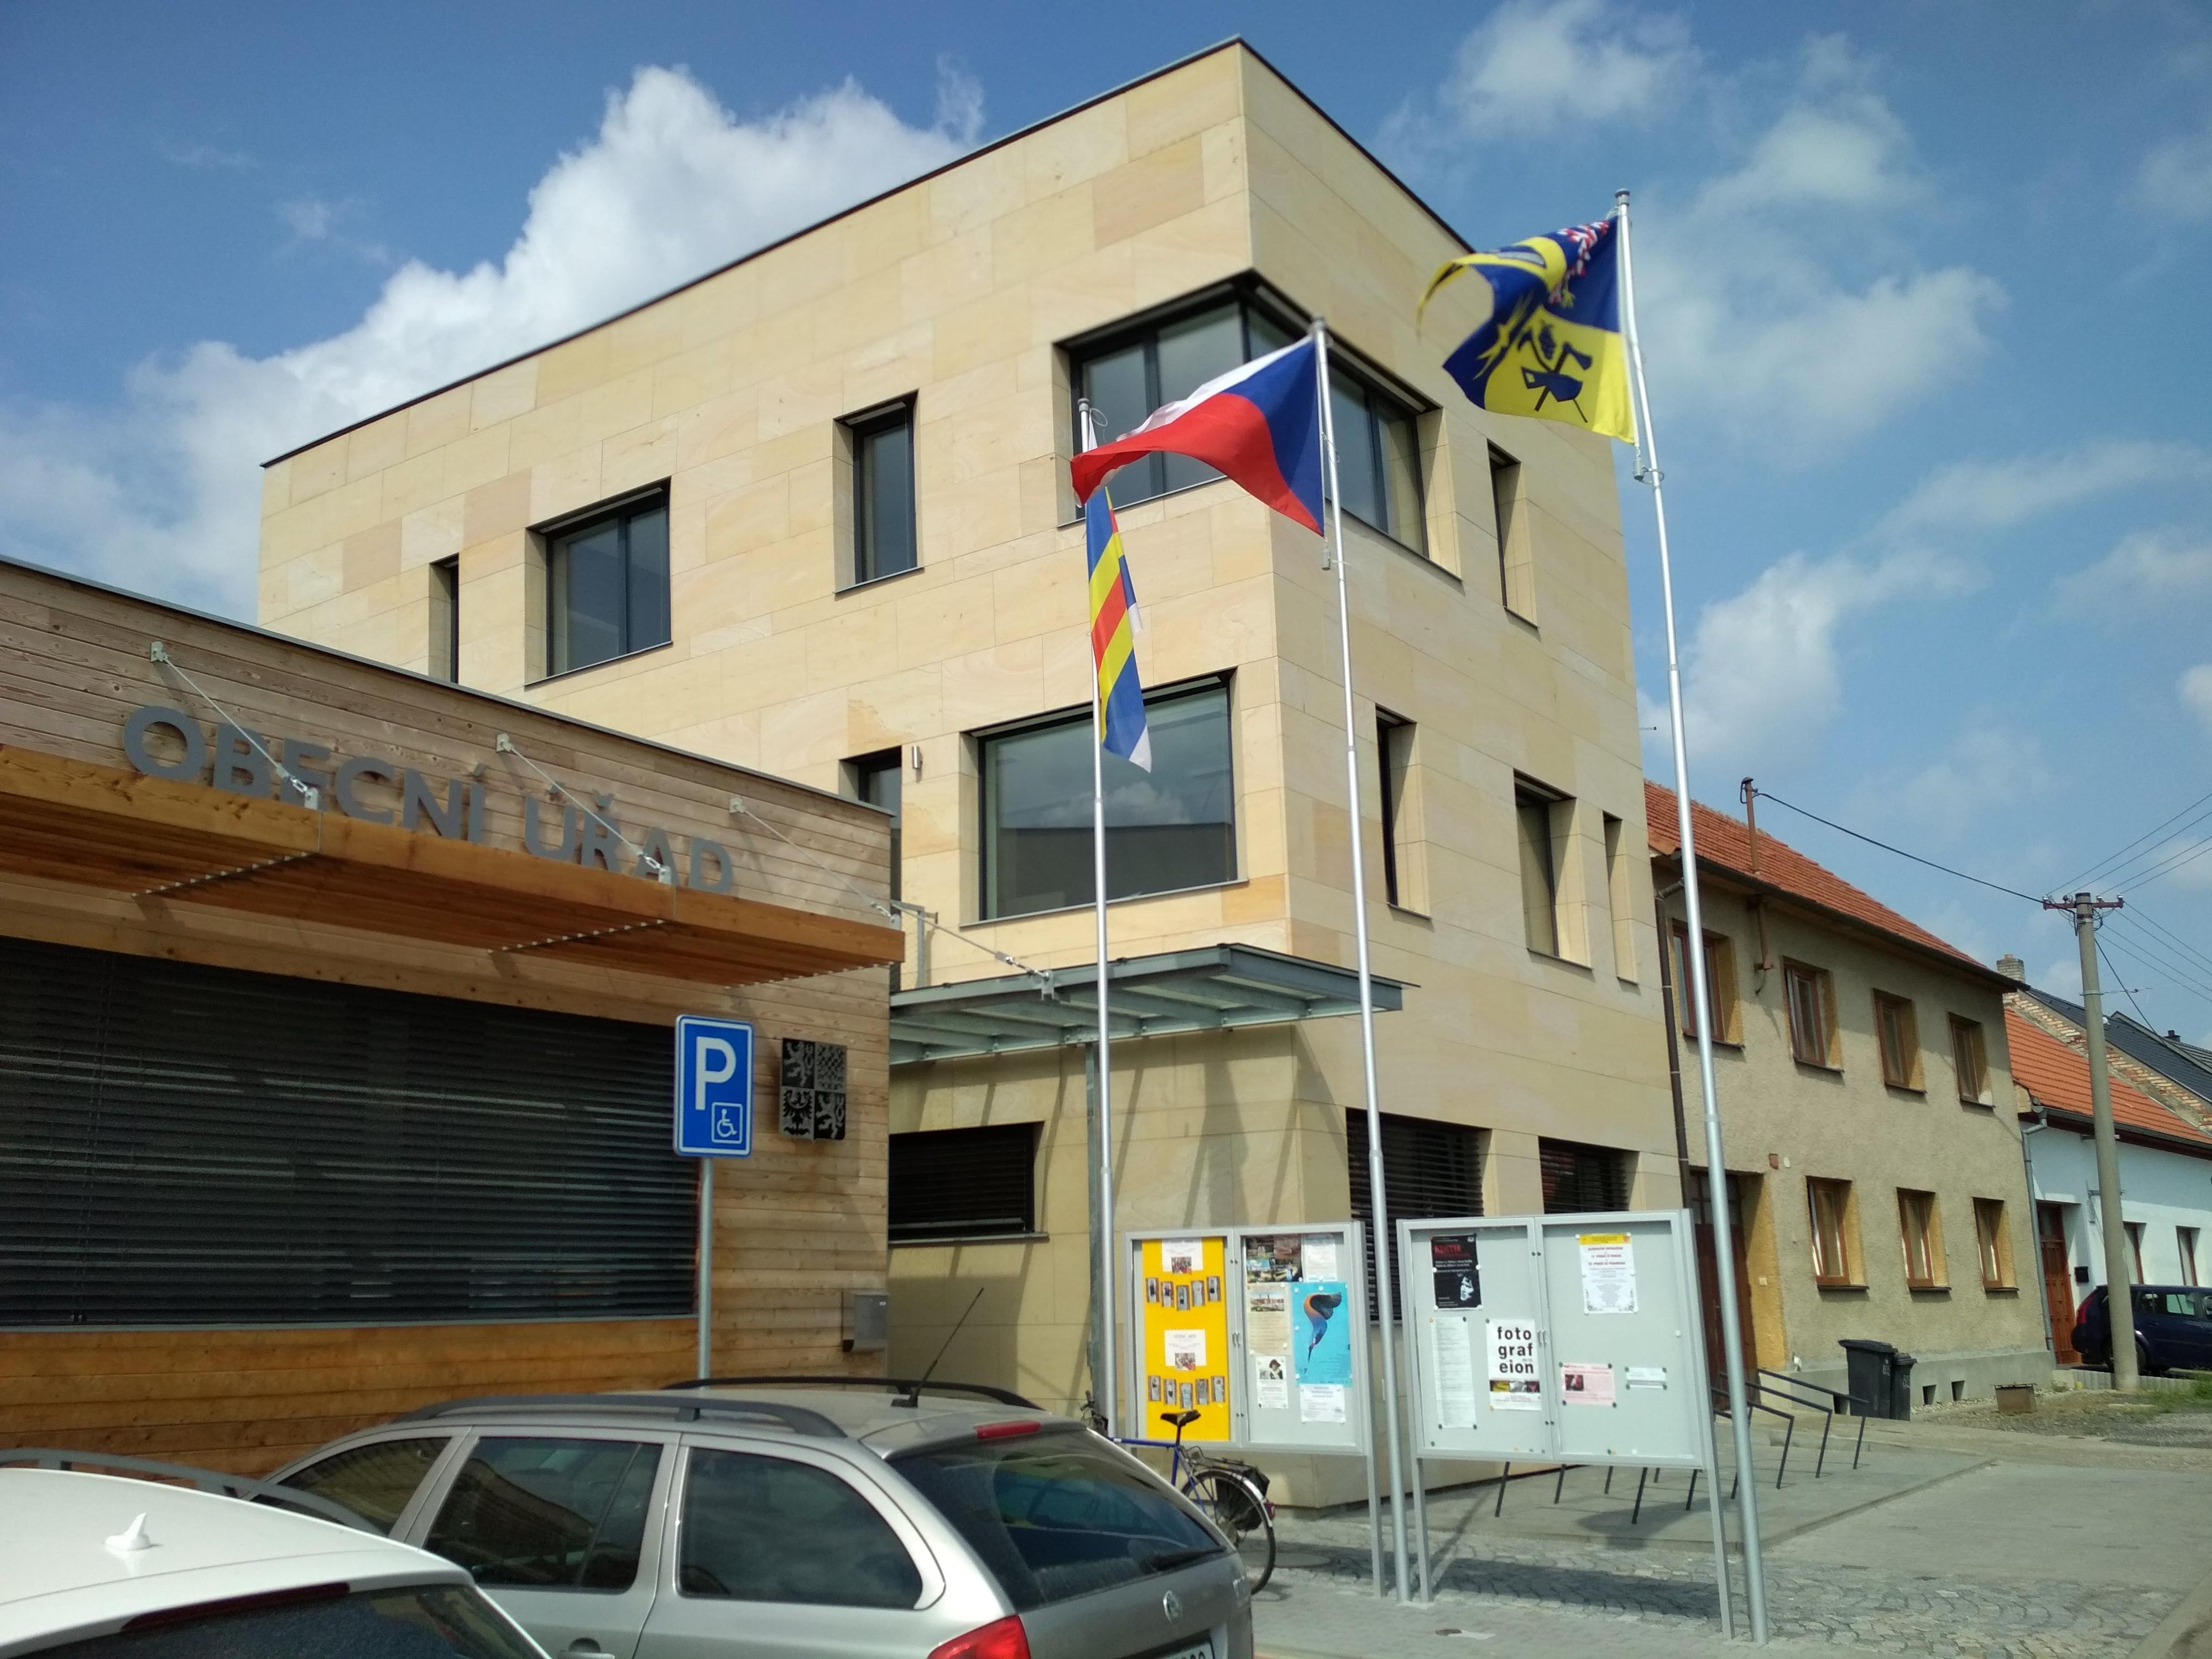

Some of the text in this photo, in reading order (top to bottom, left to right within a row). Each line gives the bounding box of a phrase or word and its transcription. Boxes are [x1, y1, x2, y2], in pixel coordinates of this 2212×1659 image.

[123, 706, 734, 894] OBECNÍ ÚŘAD
[695, 1036, 737, 1110] P
[1497, 1326, 1532, 1340] foto
[1498, 1343, 1532, 1359] graf
[1499, 1359, 1534, 1374] eion
